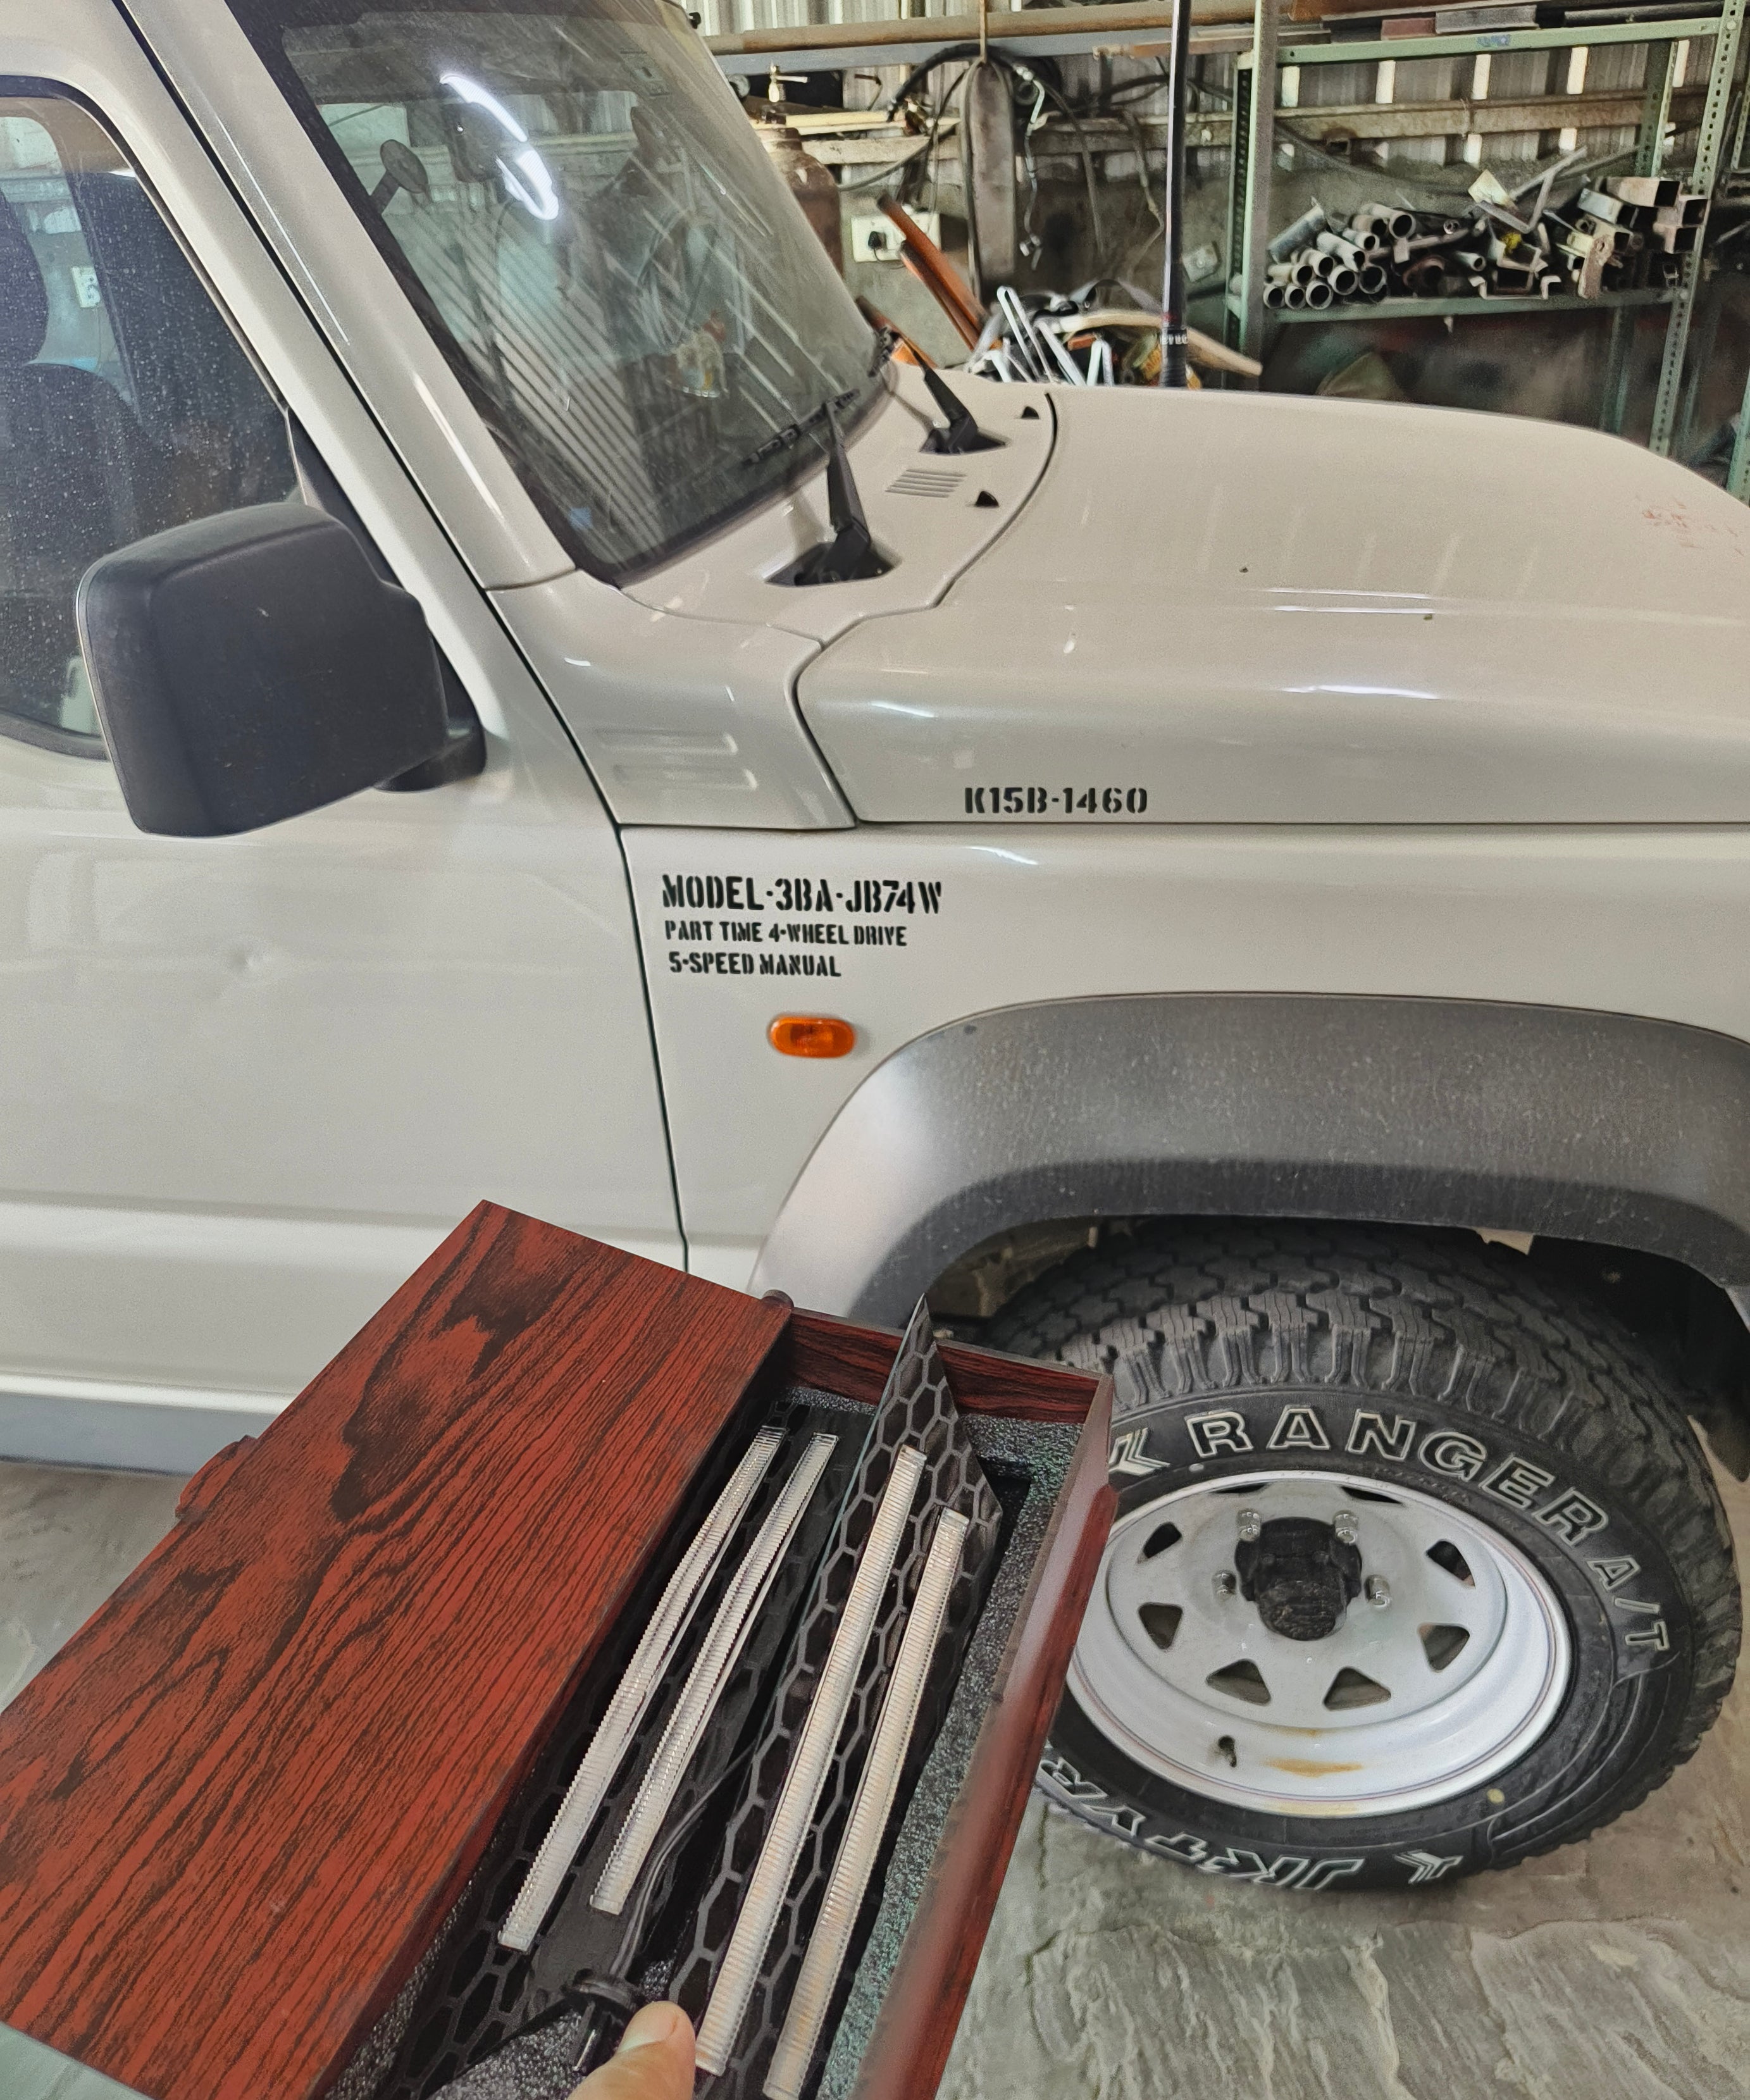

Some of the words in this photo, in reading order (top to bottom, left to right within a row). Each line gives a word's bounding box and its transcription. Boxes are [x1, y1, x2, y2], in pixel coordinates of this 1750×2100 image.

[964, 786, 1148, 814] K15B-1460
[665, 919, 714, 941] PART
[718, 921, 763, 943] TIME
[767, 923, 850, 945] 4-WHEEL
[853, 925, 908, 947] DRIVE
[668, 951, 755, 975] 5-SPEED
[759, 953, 842, 978] MANUAL
[1184, 1403, 1609, 1547] RANGER
[1586, 1555, 1671, 1652] A/T
[1034, 1739, 1208, 1863] TYR
